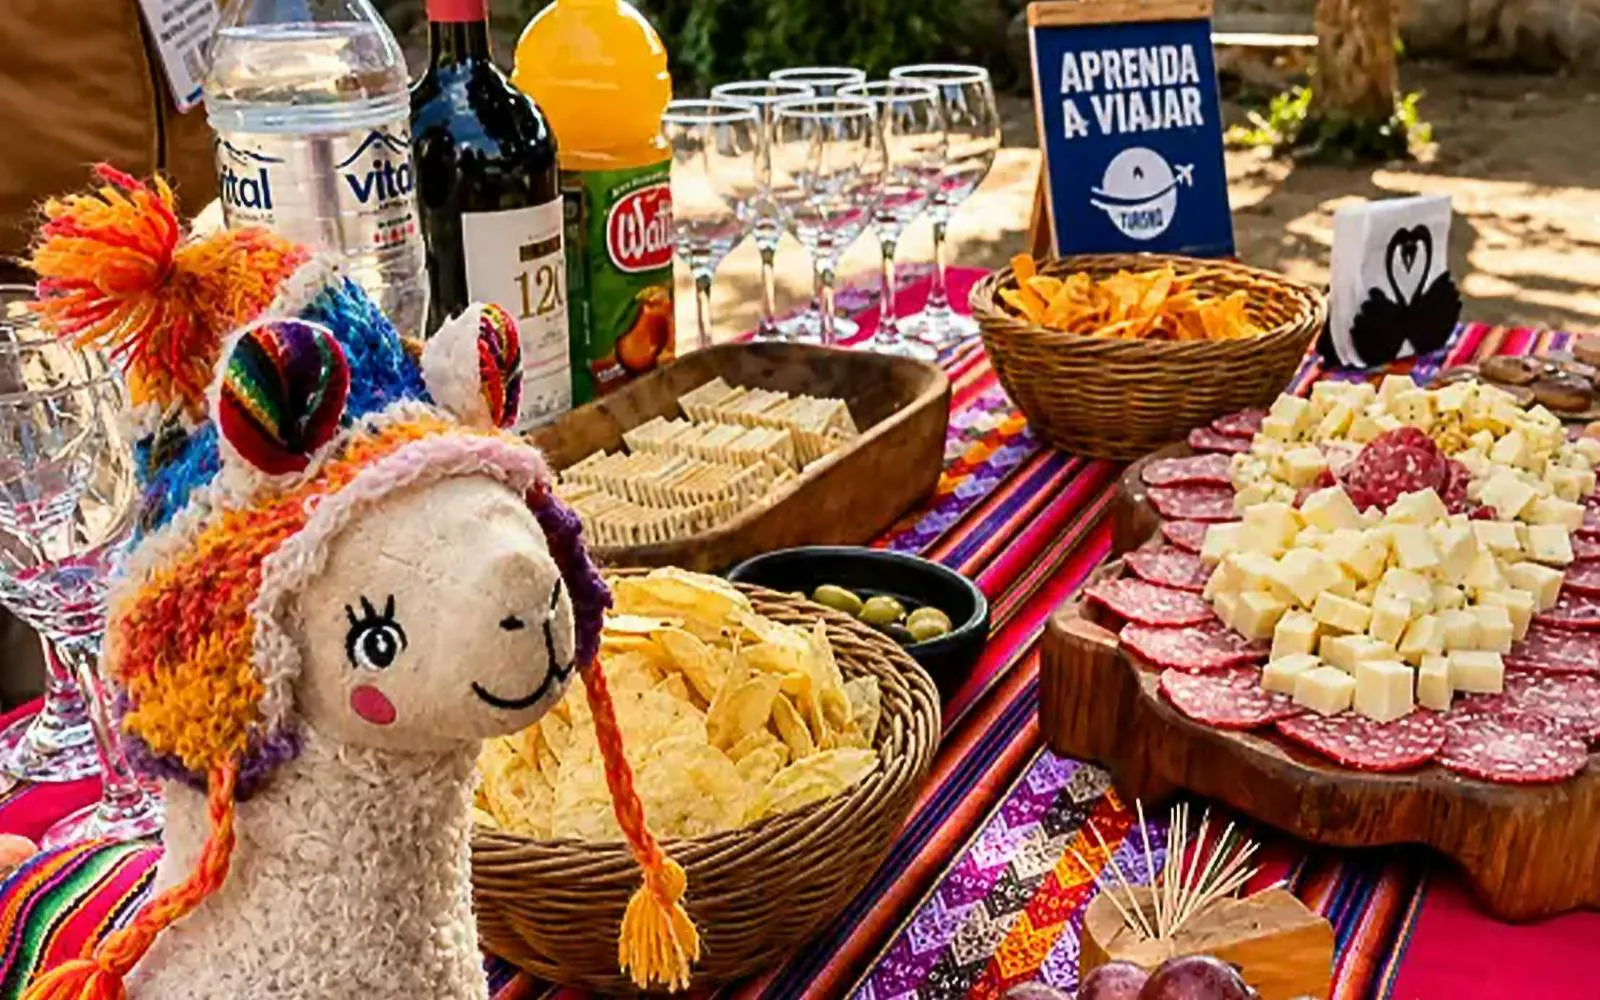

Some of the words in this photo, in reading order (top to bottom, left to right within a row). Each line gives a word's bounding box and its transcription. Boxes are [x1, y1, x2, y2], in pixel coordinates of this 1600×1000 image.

[1060, 44, 1200, 94] APRENDA
[1062, 98, 1089, 139] A
[1089, 87, 1204, 135] VIAJAR
[220, 164, 272, 210] ital
[344, 156, 413, 204] vita
